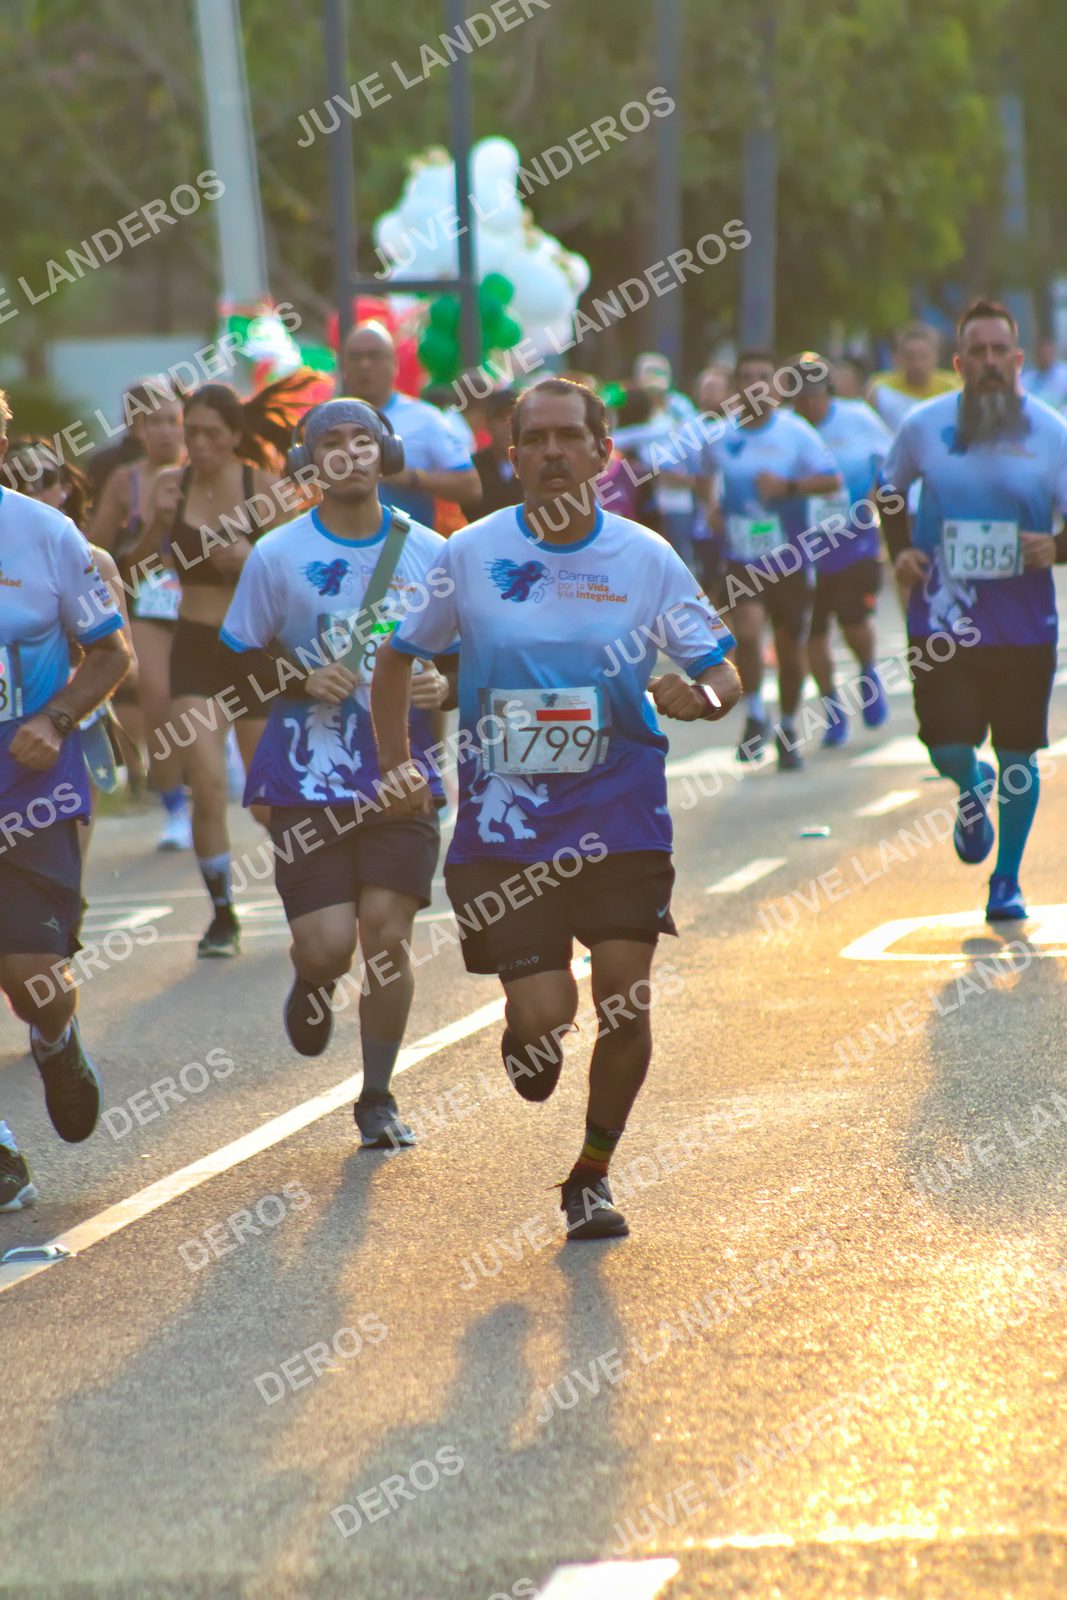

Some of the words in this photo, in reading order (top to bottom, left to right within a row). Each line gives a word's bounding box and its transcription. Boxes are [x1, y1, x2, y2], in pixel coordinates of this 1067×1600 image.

[948, 543, 1014, 571] 1385
[558, 569, 609, 583] Carrera
[588, 582, 609, 592] Vida
[576, 590, 628, 603] Integridad
[501, 726, 595, 763] 1799
